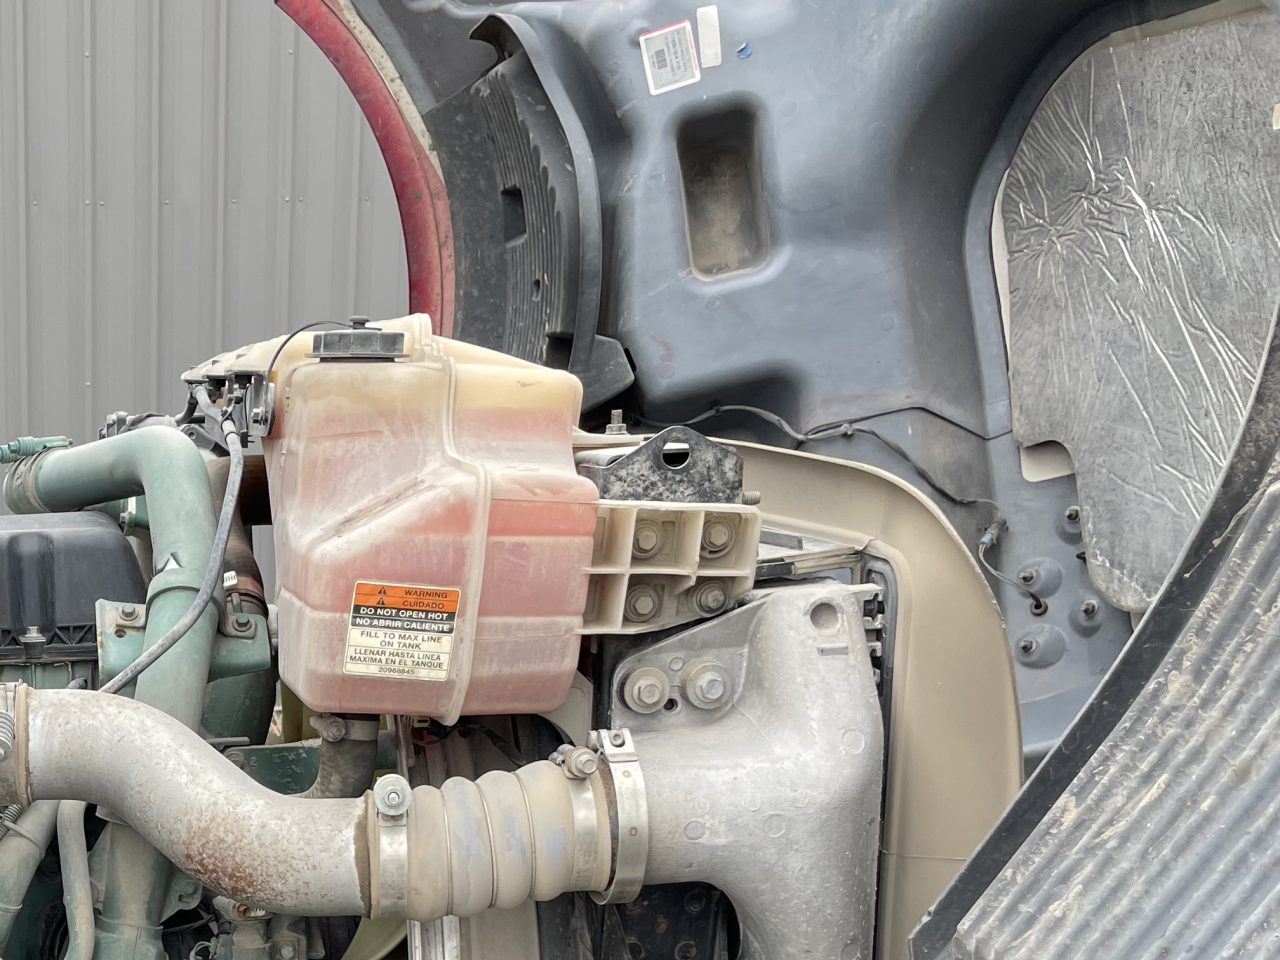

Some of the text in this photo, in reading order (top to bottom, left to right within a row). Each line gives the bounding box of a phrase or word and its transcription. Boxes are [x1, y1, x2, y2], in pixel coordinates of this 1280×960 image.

[404, 589, 448, 599] WARNING
[402, 600, 445, 610] CUIDADO
[399, 610, 426, 619] OPEN
[427, 612, 449, 620] HOT
[356, 617, 450, 632] NO ABRIR CALIENTE
[360, 630, 443, 643] FILL TO MAX LINE
[397, 641, 422, 650] TANK
[354, 648, 441, 661] LLENAR HASTA LINEA
[349, 655, 383, 664] MAXIMA
[384, 657, 397, 665] EN
[411, 660, 444, 669] TANQUE
